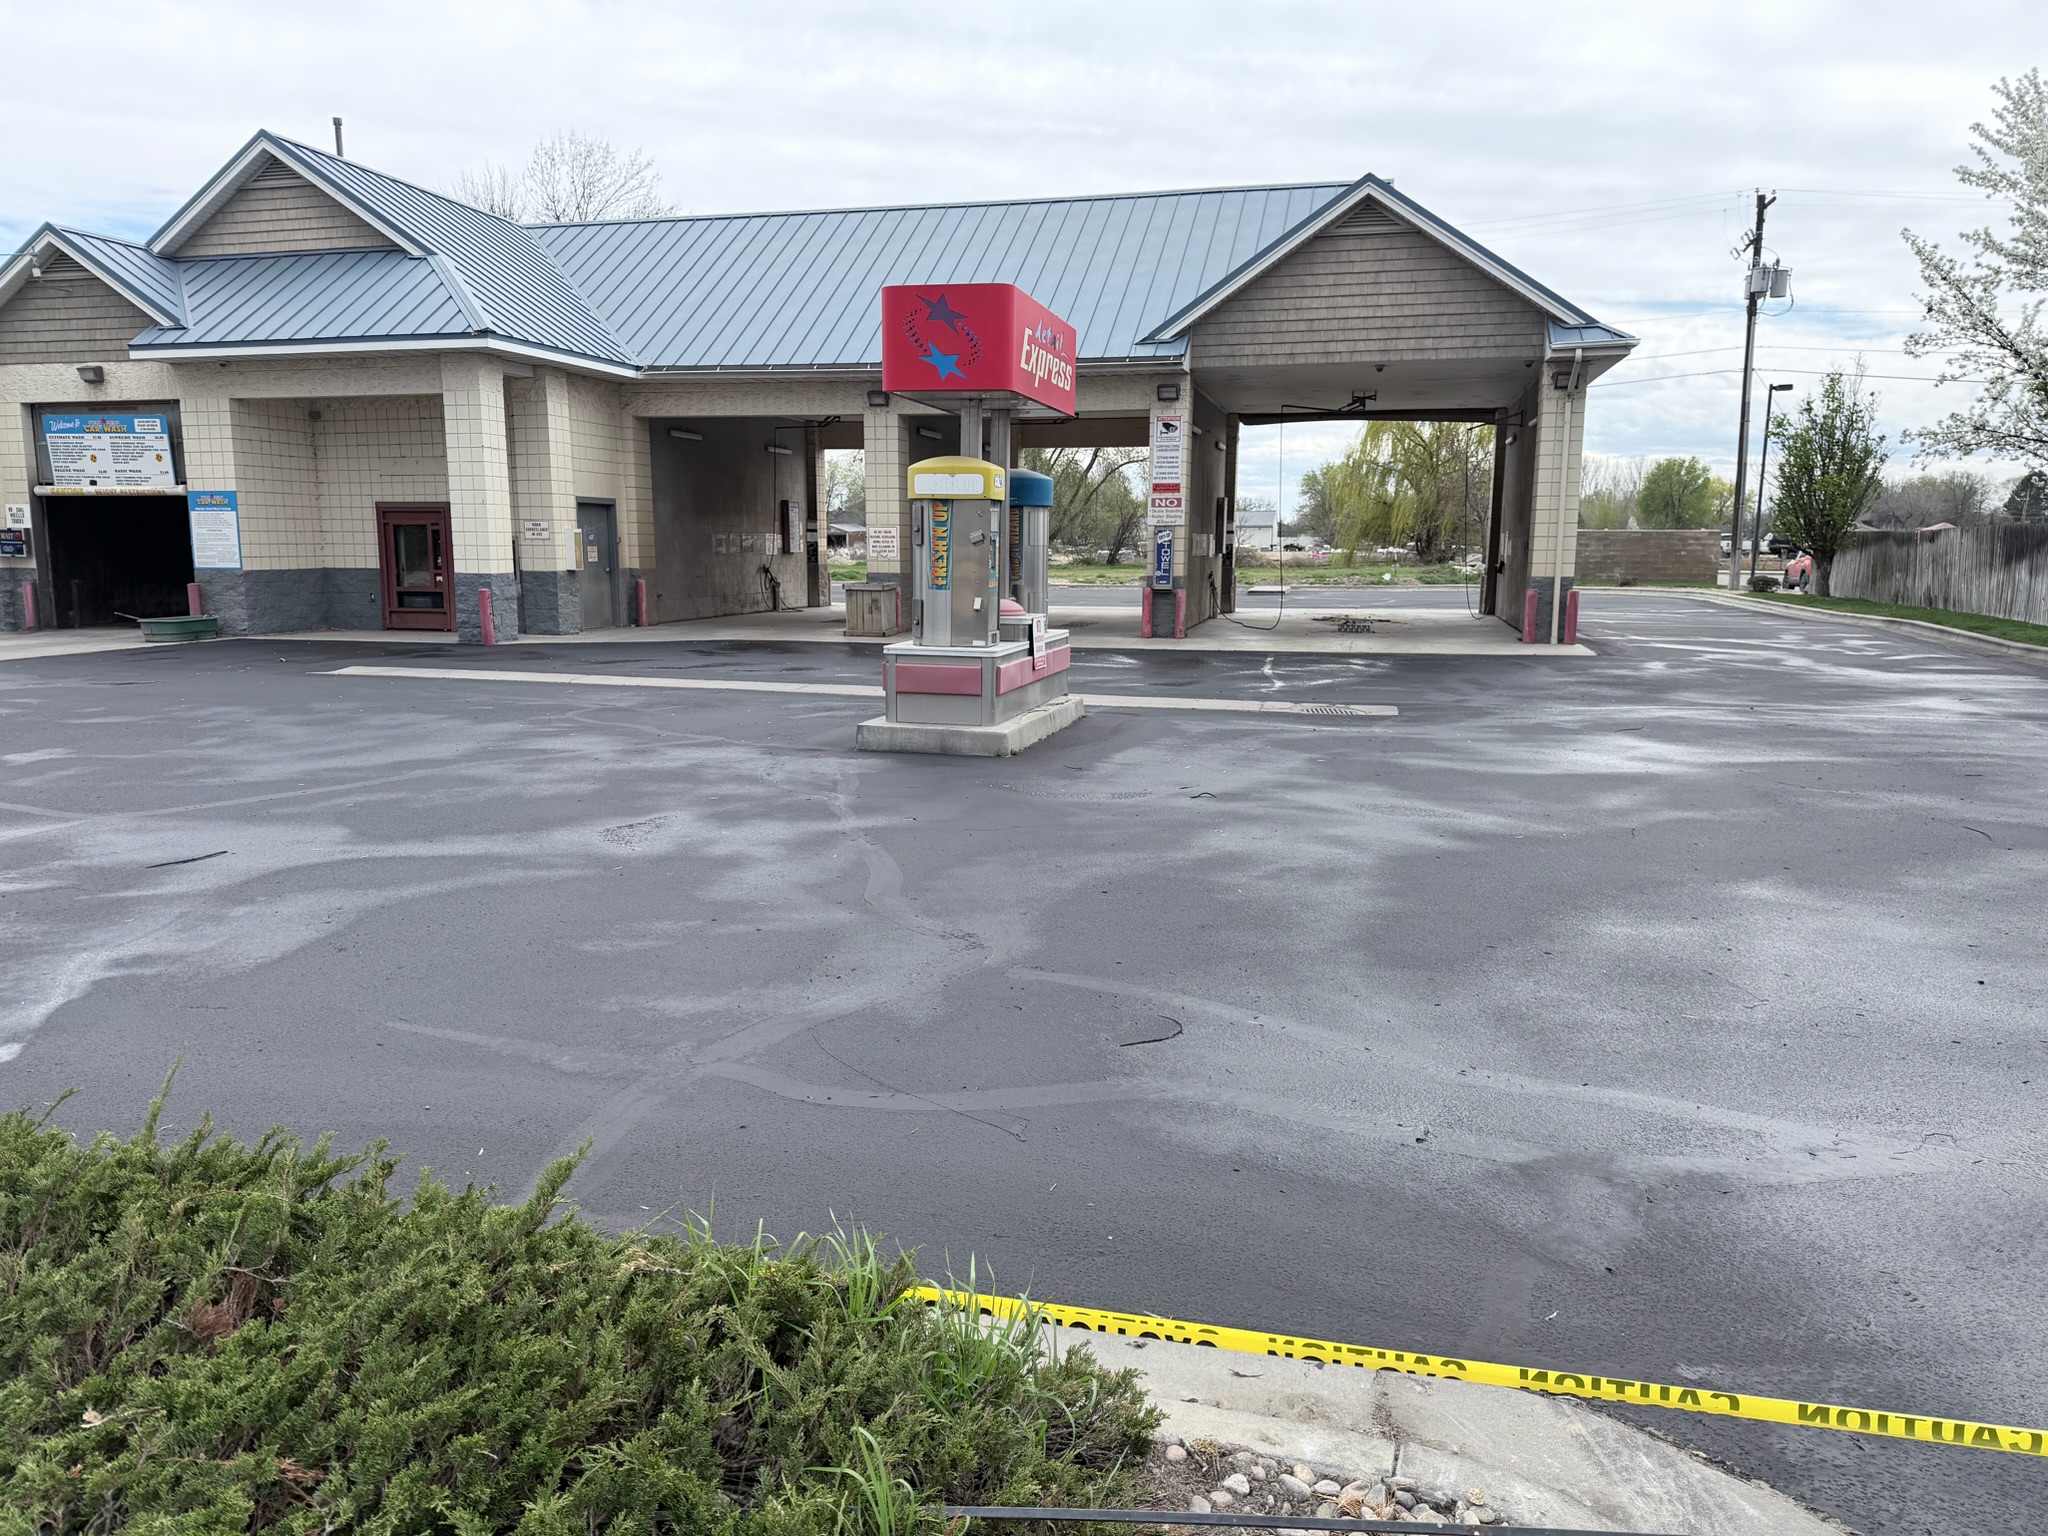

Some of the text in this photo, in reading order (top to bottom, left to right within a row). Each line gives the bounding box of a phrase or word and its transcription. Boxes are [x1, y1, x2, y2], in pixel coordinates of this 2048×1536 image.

[1020, 326, 1073, 392] Express
[49, 418, 80, 432] Welcome to
[83, 425, 100, 433] CAR
[103, 425, 126, 433] WASH
[931, 501, 949, 586] FRESH'N UP
[1161, 542, 1170, 576] TOWEL
